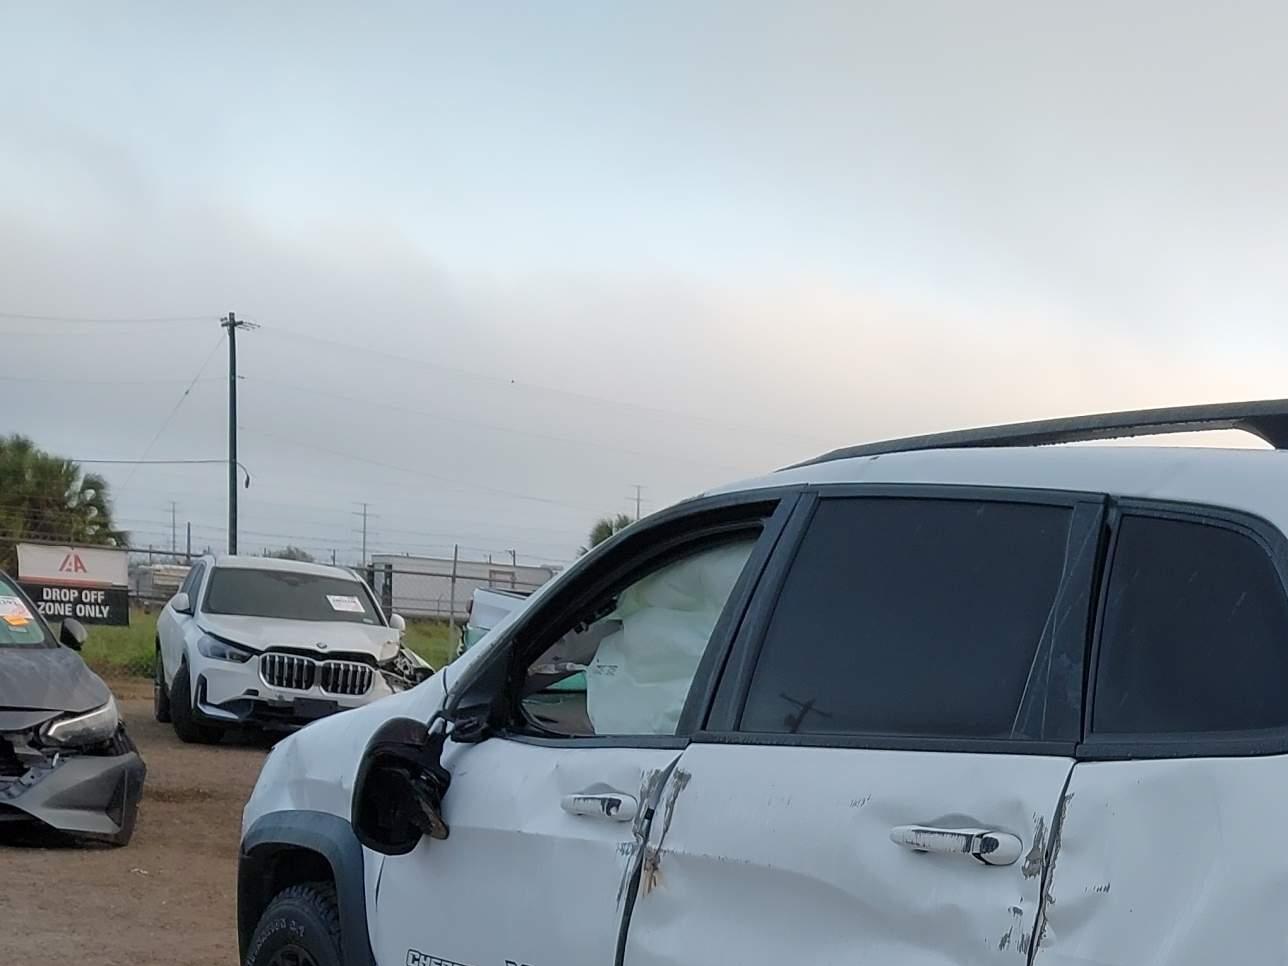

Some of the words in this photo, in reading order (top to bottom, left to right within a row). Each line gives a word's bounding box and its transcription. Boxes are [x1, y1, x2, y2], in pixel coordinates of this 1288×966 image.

[42, 587, 78, 602] DROP
[81, 590, 105, 604] OFF
[38, 601, 73, 616] ZONE
[75, 604, 110, 618] ONLY
